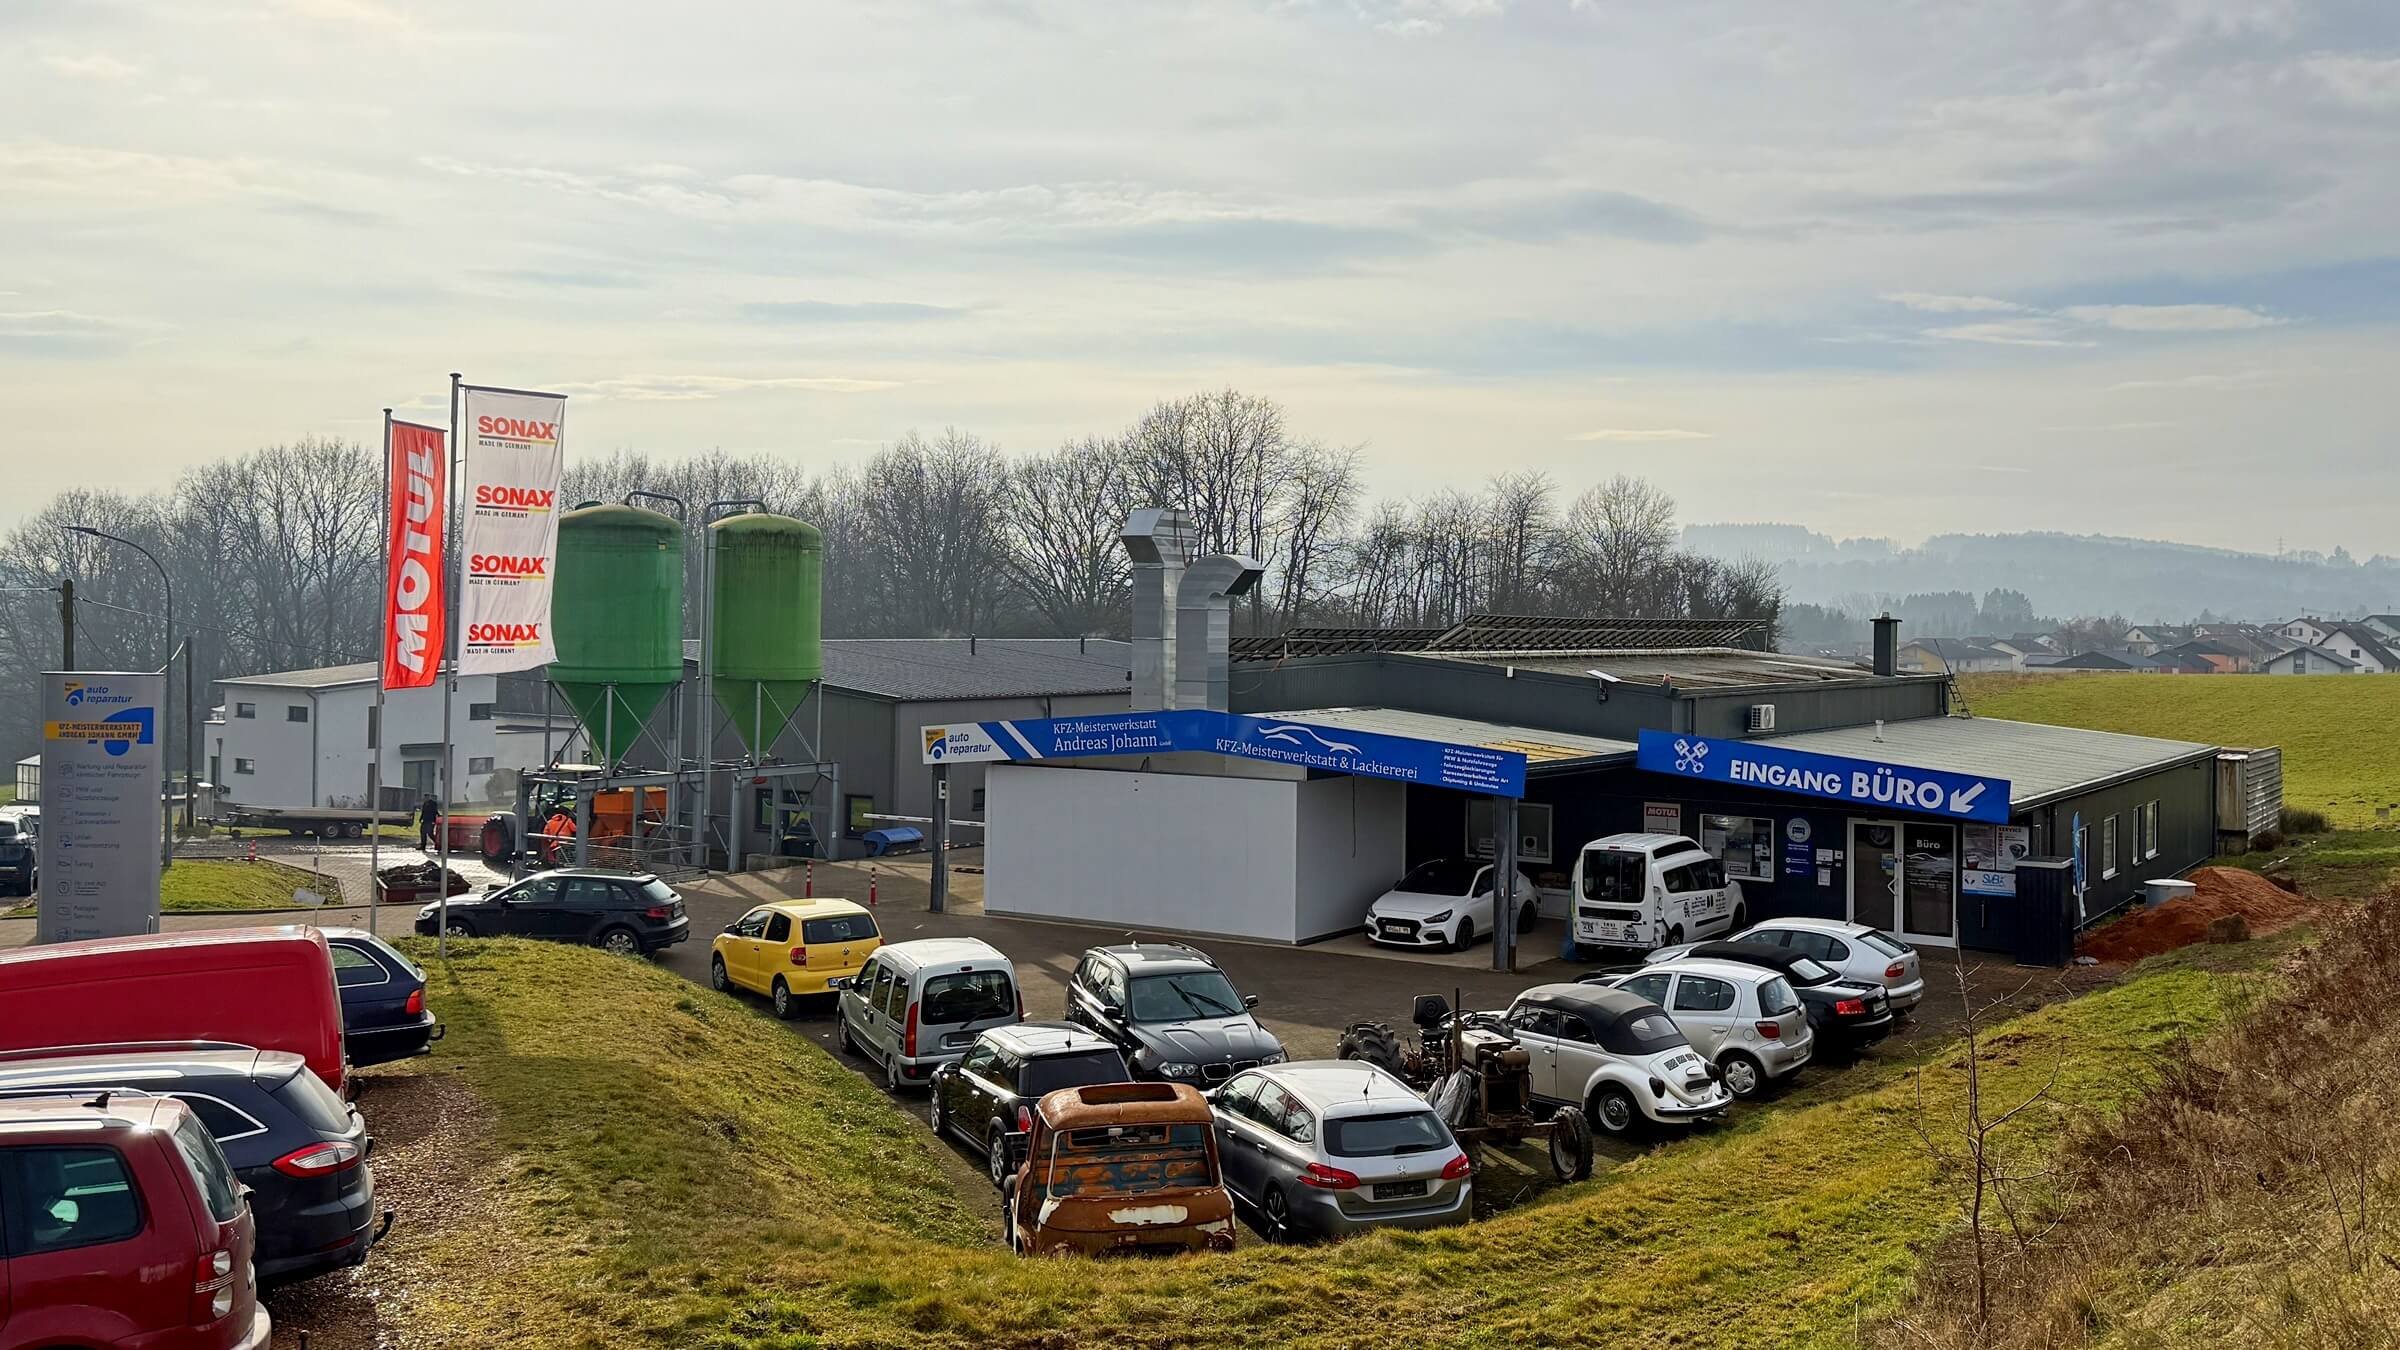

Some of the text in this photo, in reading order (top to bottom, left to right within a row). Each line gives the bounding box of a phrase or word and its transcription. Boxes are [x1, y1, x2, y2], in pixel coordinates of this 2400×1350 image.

[479, 416, 555, 440] SONAX
[479, 440, 494, 448] MADE
[505, 442, 531, 450] GERMANY
[476, 485, 554, 507] SONAX
[475, 510, 490, 518] MADE
[501, 511, 528, 519] GERMANY
[395, 445, 434, 674] MOTUL
[470, 555, 545, 574] SONAX
[469, 623, 540, 642] SONAX
[87, 686, 109, 695] auto
[86, 695, 133, 704] reparatur
[1053, 719, 1157, 735] KFZ-Meisterwerkstatt
[949, 732, 969, 743] auto
[1054, 736, 1108, 752] Andreas
[1111, 732, 1157, 752] Johann
[949, 743, 992, 756] reparatur
[1215, 738, 1418, 779] KFZ-Meisterwerkstatt & Lackiererei
[1729, 759, 1944, 809] EINGANG BÜRO
[1647, 807, 1678, 817] MOTUL
[1916, 839, 1941, 849] Büro
